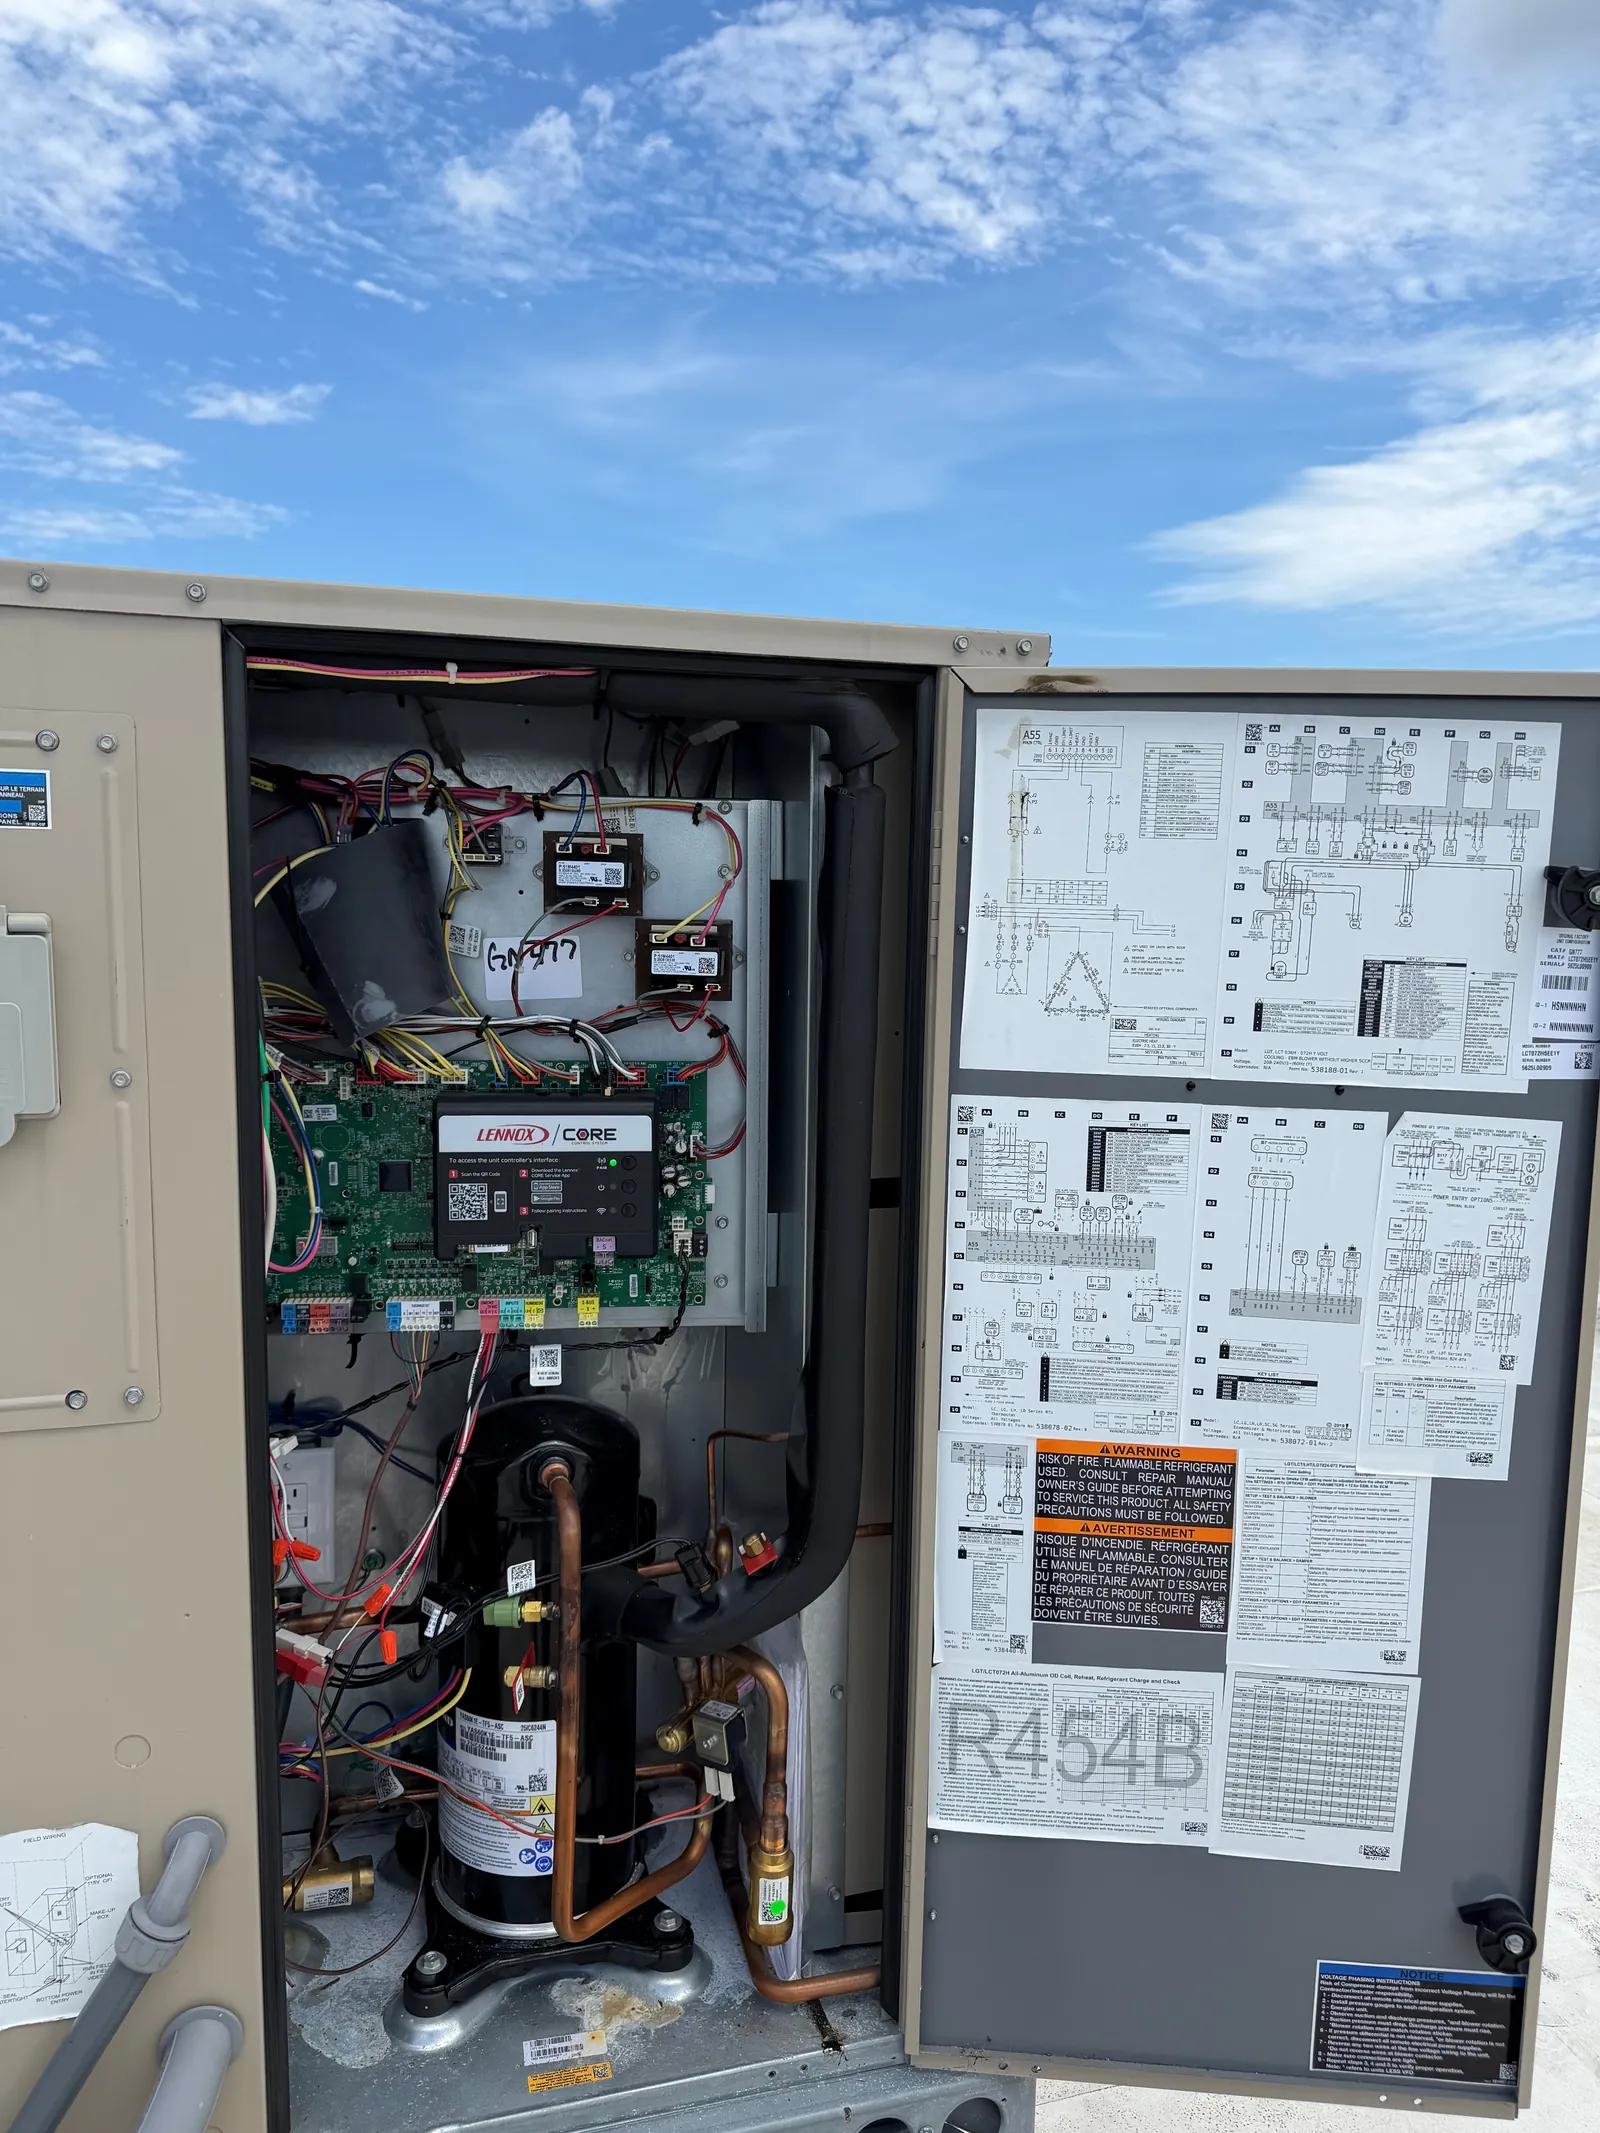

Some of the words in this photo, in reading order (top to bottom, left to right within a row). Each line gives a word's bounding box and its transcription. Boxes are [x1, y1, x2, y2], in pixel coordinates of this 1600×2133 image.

[1023, 730, 1041, 740] A55
[476, 1128, 535, 1142] LENNOX
[563, 1128, 617, 1141] CORE
[1112, 1446, 1181, 1458] WARNING
[1038, 1454, 1060, 1464] RISK
[1062, 1455, 1075, 1465] OF
[1078, 1456, 1102, 1467] FIRE.
[1104, 1458, 1161, 1471] FLAMMABLE
[1164, 1462, 1233, 1474] REFRIGERANT
[1038, 1467, 1068, 1477] USED.
[1079, 1470, 1127, 1481] CONSULT
[1138, 1473, 1175, 1484] REPAIR
[1187, 1475, 1233, 1486] MANUAL/
[1038, 1479, 1084, 1491] OWNER'S
[1087, 1482, 1119, 1493] GUIDE
[1122, 1484, 1163, 1495] BEFORE
[1166, 1487, 1231, 1499] ATTEMPTING
[1037, 1492, 1050, 1501] TO
[1053, 1492, 1094, 1504] SERVICE
[1097, 1495, 1119, 1505] THIS
[1121, 1497, 1171, 1509] PRODUCT.
[1174, 1500, 1190, 1510] ALL
[1193, 1501, 1231, 1512] SAFETY
[1037, 1505, 1112, 1518] PRECAUTIONS
[1115, 1510, 1144, 1521] MUST
[1147, 1512, 1161, 1521] BE
[1164, 1513, 1226, 1525] FOLLOWED.
[1093, 1524, 1195, 1538] AVERTISSEMENT
[1036, 1534, 1077, 1546] RISQUE
[1082, 1537, 1146, 1550] D'INCENDIE.
[1151, 1540, 1229, 1555] RÉFRIGÉRANT
[1036, 1546, 1076, 1558] UTILISÉ
[1079, 1549, 1158, 1564] INFLAMMABLE.
[1161, 1554, 1228, 1567] CONSULTER
[1036, 1560, 1048, 1569] LE
[1051, 1560, 1095, 1573] MANUEL
[1098, 1563, 1112, 1573] DE
[1115, 1563, 1185, 1578] RÉPARATION
[1194, 1569, 1227, 1580] GUIDE
[1035, 1572, 1049, 1581] DU
[1052, 1572, 1128, 1587] PROPRIÉTAIRE
[1130, 1578, 1165, 1589] AVANT
[1035, 1584, 1047, 1593] DE
[1050, 1584, 1094, 1597] RÉPARER
[1096, 1588, 1109, 1598] CE
[1112, 1588, 1155, 1600] PRODUIT.
[1158, 1591, 1195, 1602] TOUTES
[1034, 1596, 1052, 1606] LES
[1055, 1596, 1125, 1611] PRÉCAUTIONS
[1128, 1602, 1142, 1612] DE
[1144, 1601, 1194, 1615] SÉCURITÉ
[1034, 1608, 1081, 1621] DOIVENT
[1084, 1609, 1112, 1622] ÊTRE
[1115, 1614, 1160, 1625] SUIVIES.
[949, 1703, 1202, 1789] R454B
[43, 1832, 66, 1841] WIRING
[1400, 1969, 1444, 1981] NOTICE
